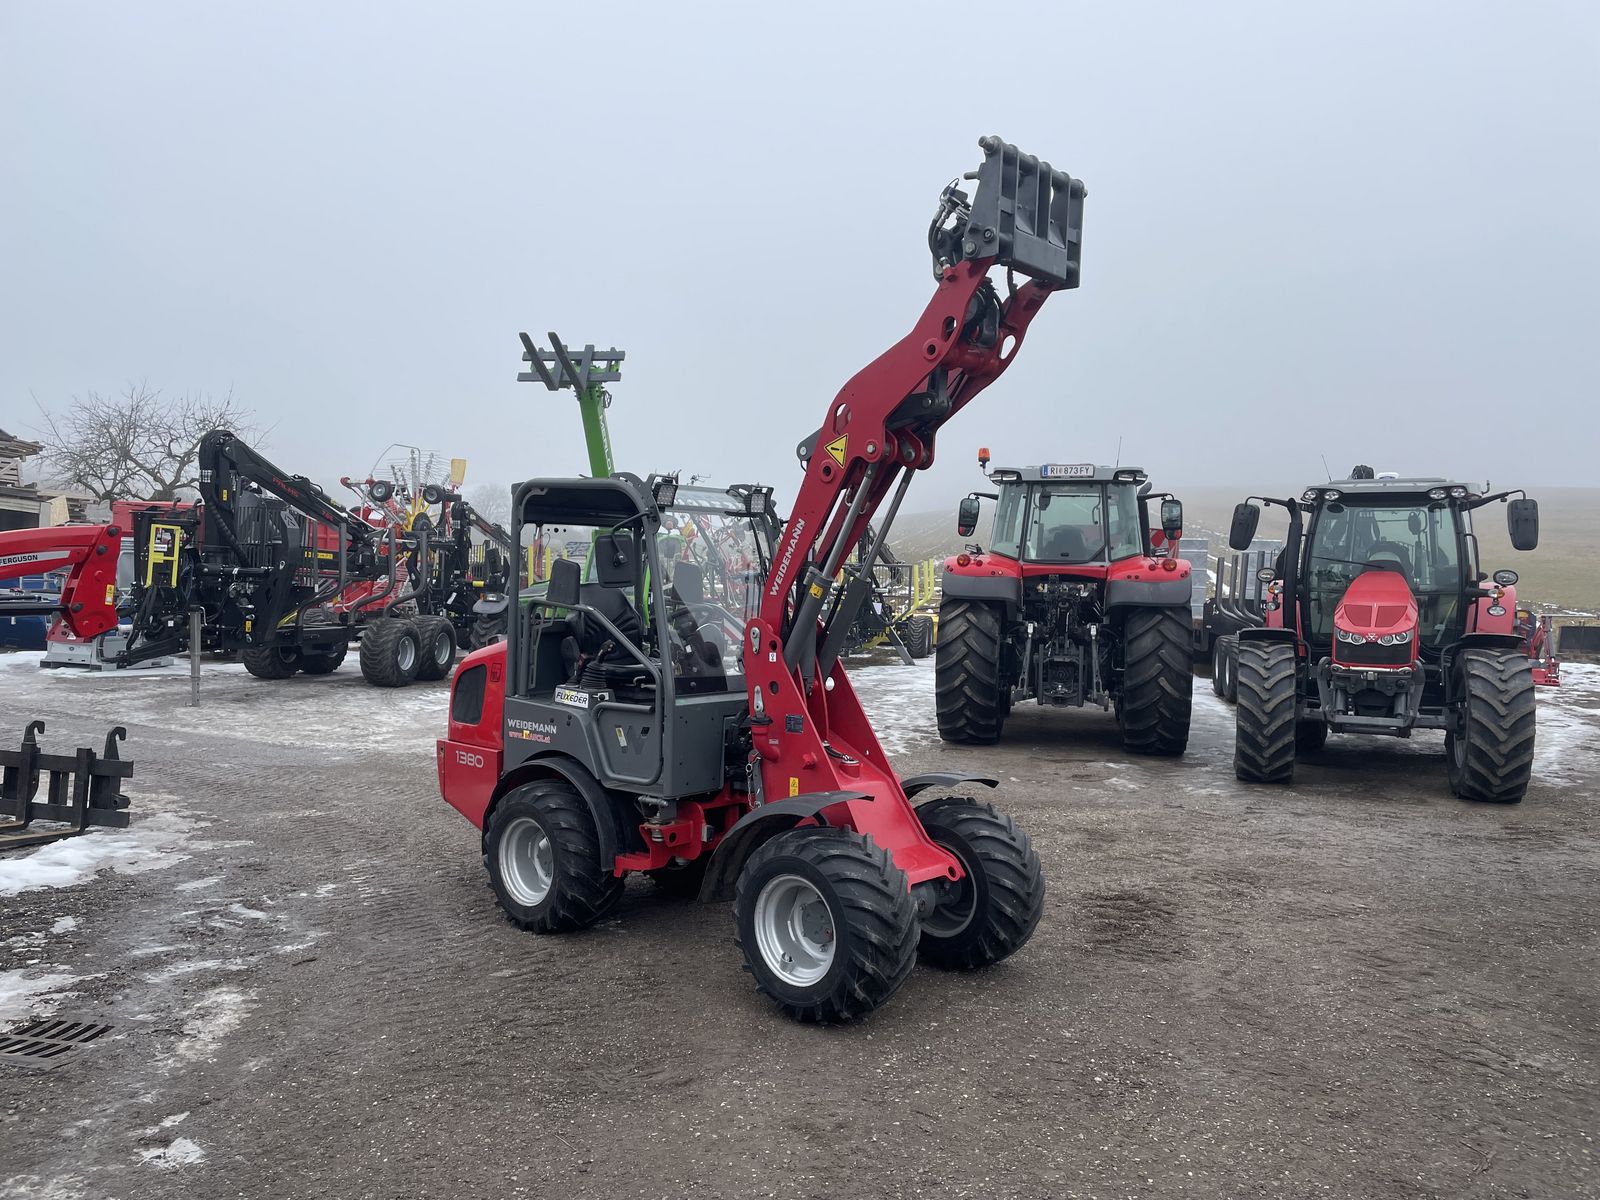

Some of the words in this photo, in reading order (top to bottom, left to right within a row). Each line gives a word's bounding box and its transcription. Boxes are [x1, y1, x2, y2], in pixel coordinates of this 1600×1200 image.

[1050, 466, 1058, 475] RI
[769, 517, 806, 597] WEIDEMANN
[507, 718, 557, 734] WEIDEMANN
[455, 750, 484, 768] 1380
